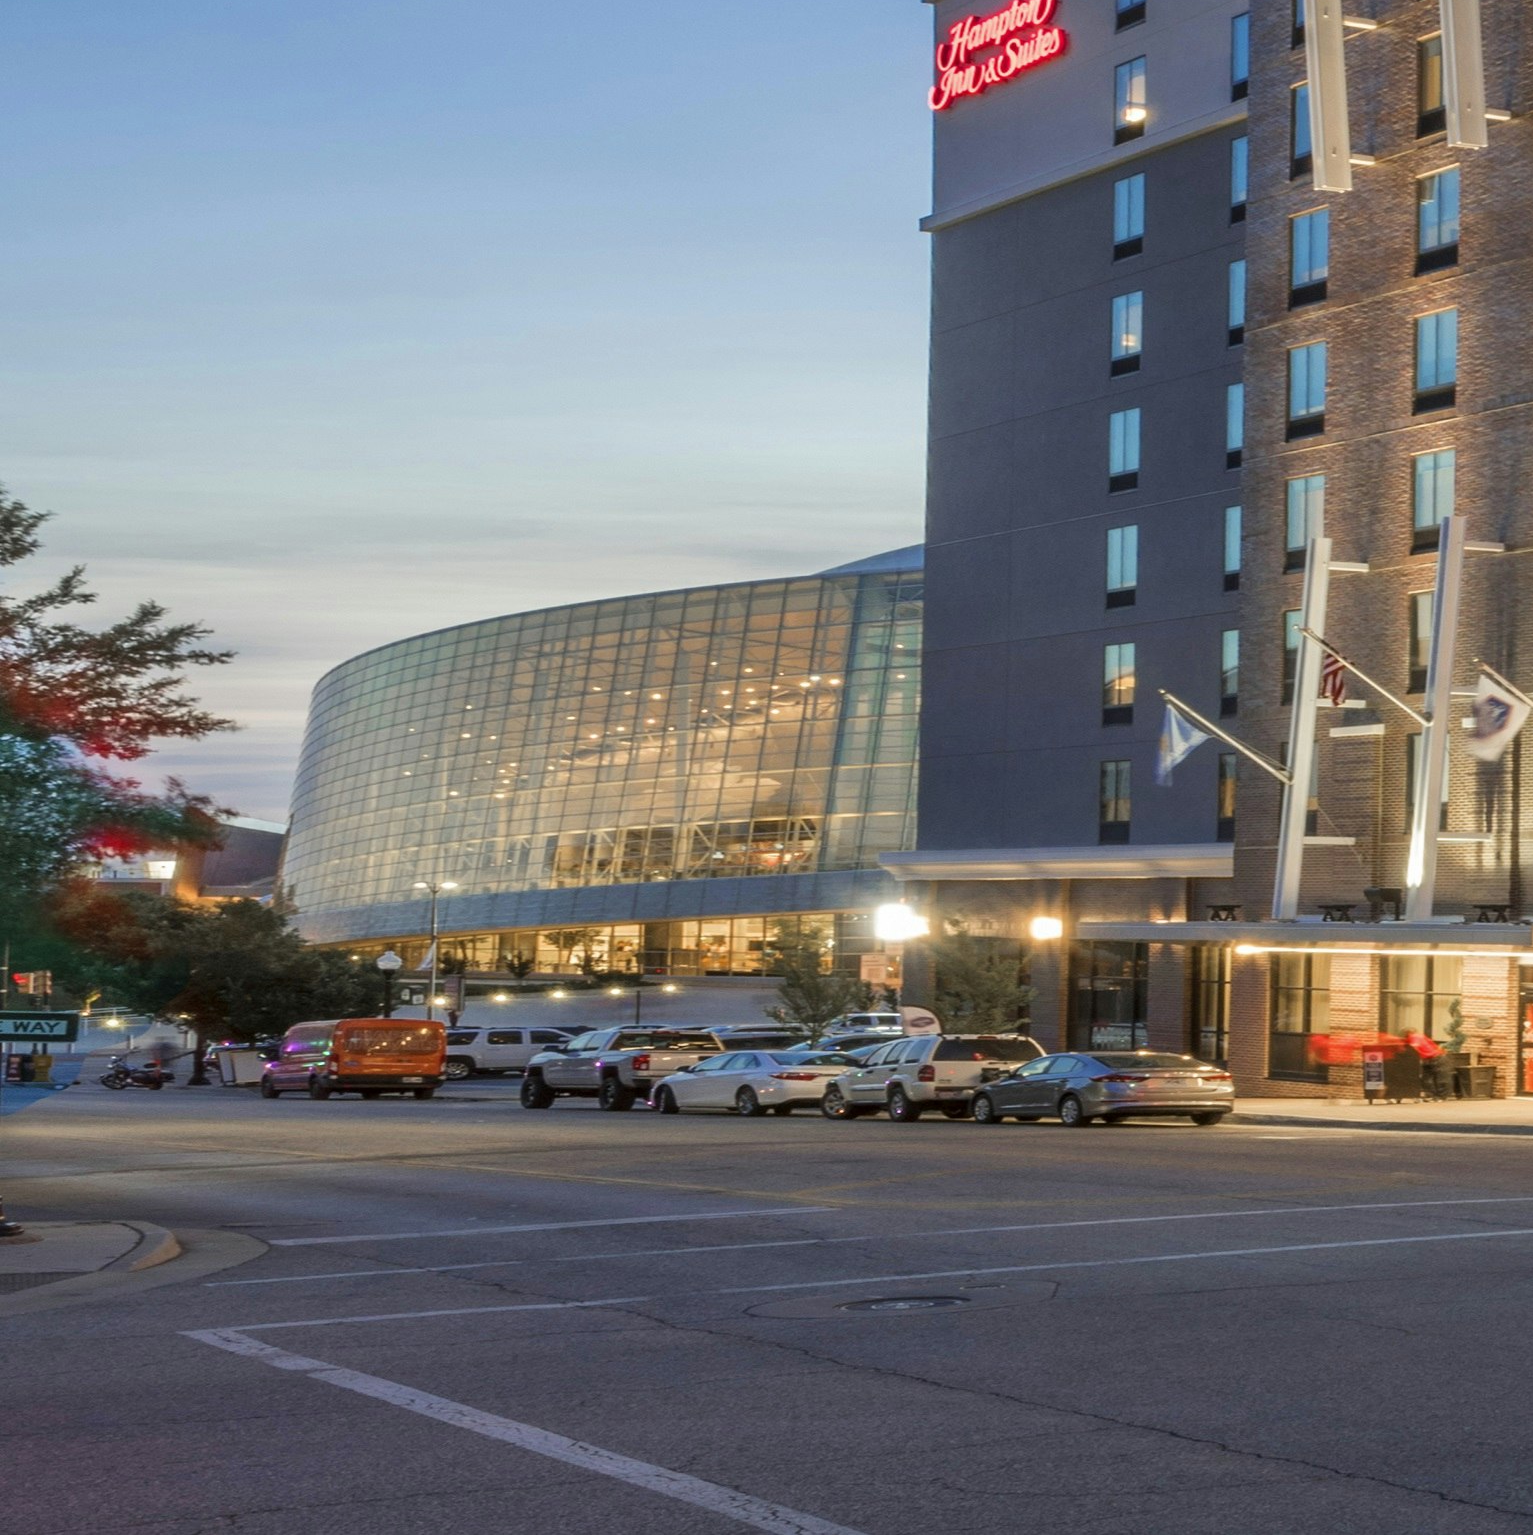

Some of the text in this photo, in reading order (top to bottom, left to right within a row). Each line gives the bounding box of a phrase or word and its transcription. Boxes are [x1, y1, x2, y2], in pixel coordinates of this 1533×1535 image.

[928, 28, 1060, 110] Inn & Suites
[14, 1021, 60, 1033] WAY
